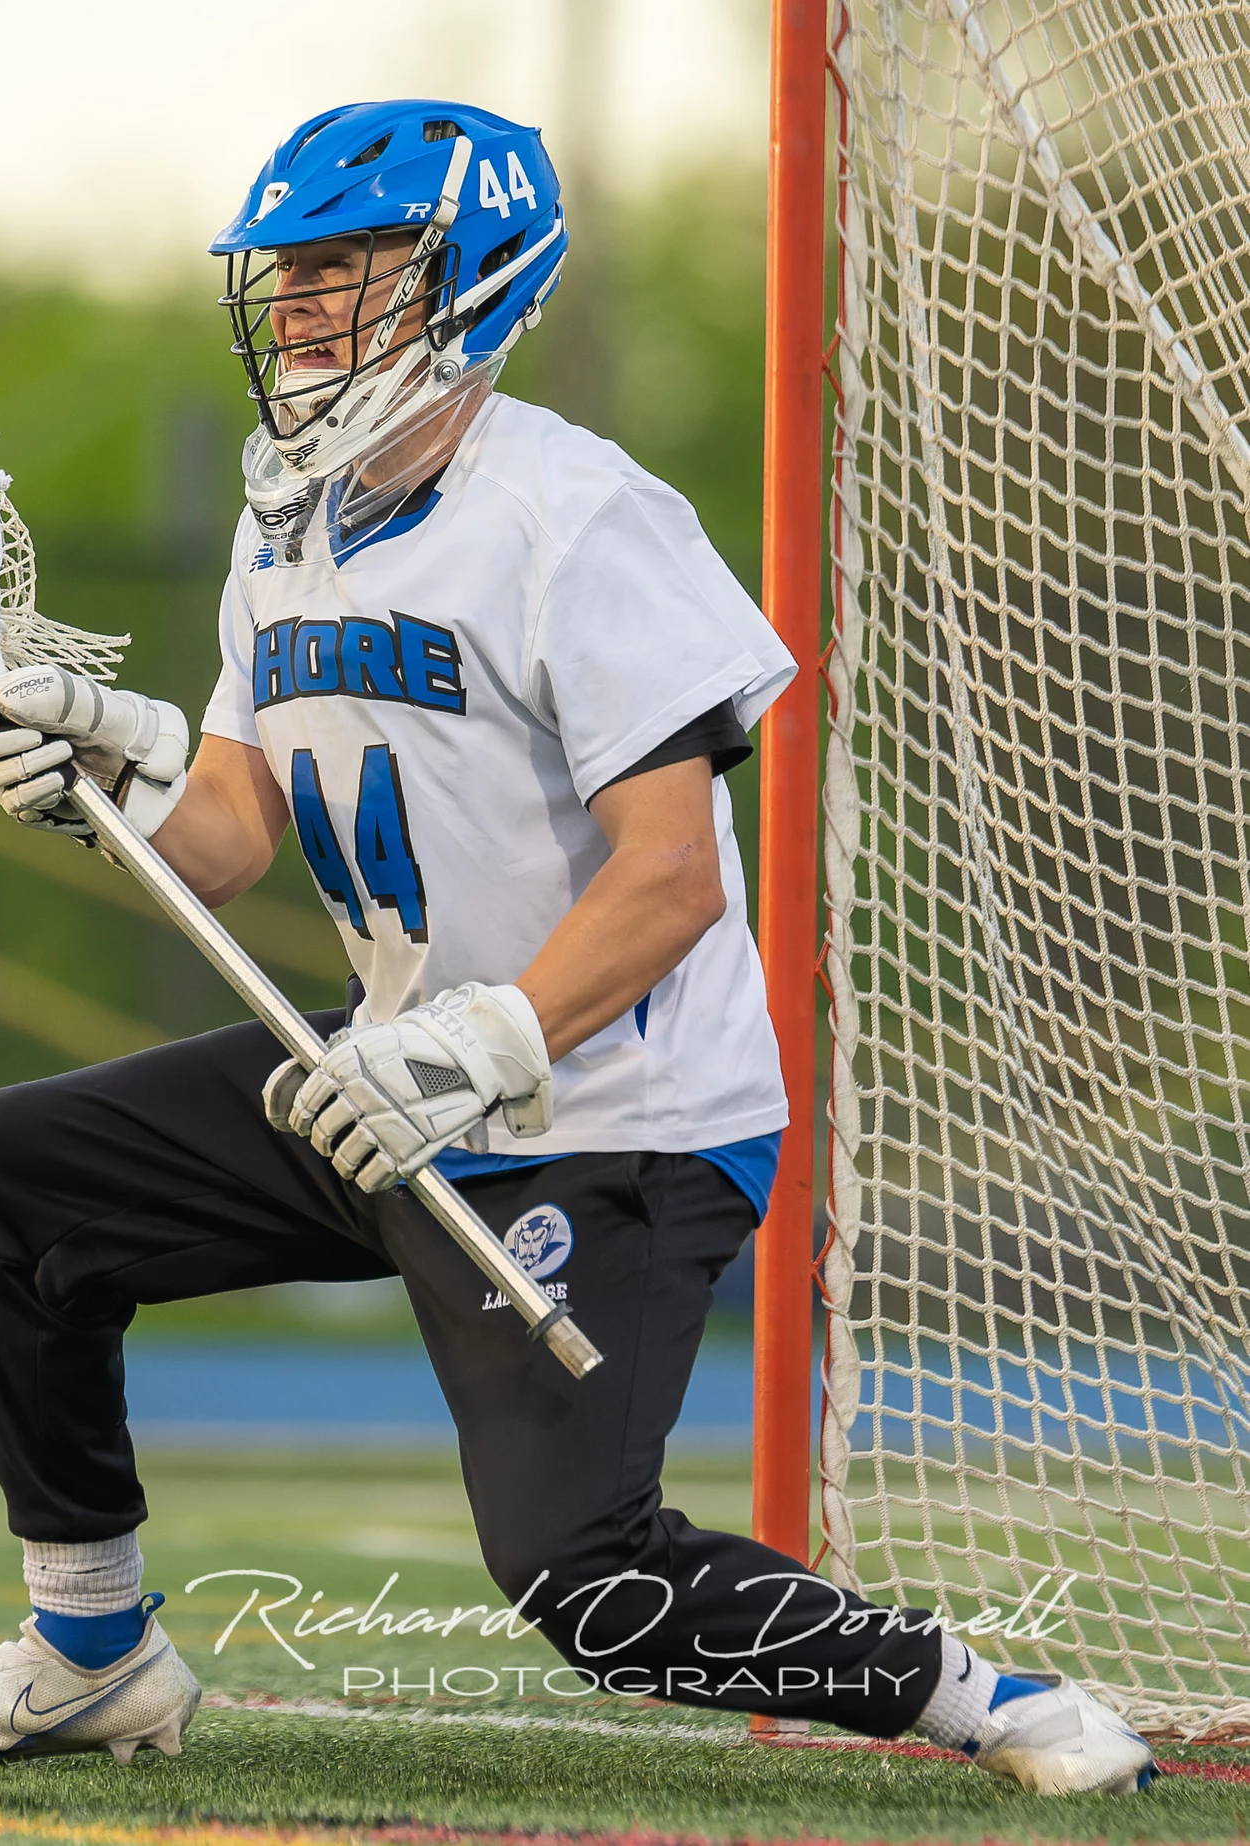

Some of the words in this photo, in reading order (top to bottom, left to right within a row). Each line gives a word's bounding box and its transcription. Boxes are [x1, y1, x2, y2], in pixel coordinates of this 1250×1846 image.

[478, 150, 538, 219] 44
[3, 676, 55, 698] TORQUE
[253, 609, 467, 716] HORE
[291, 743, 429, 944] 44
